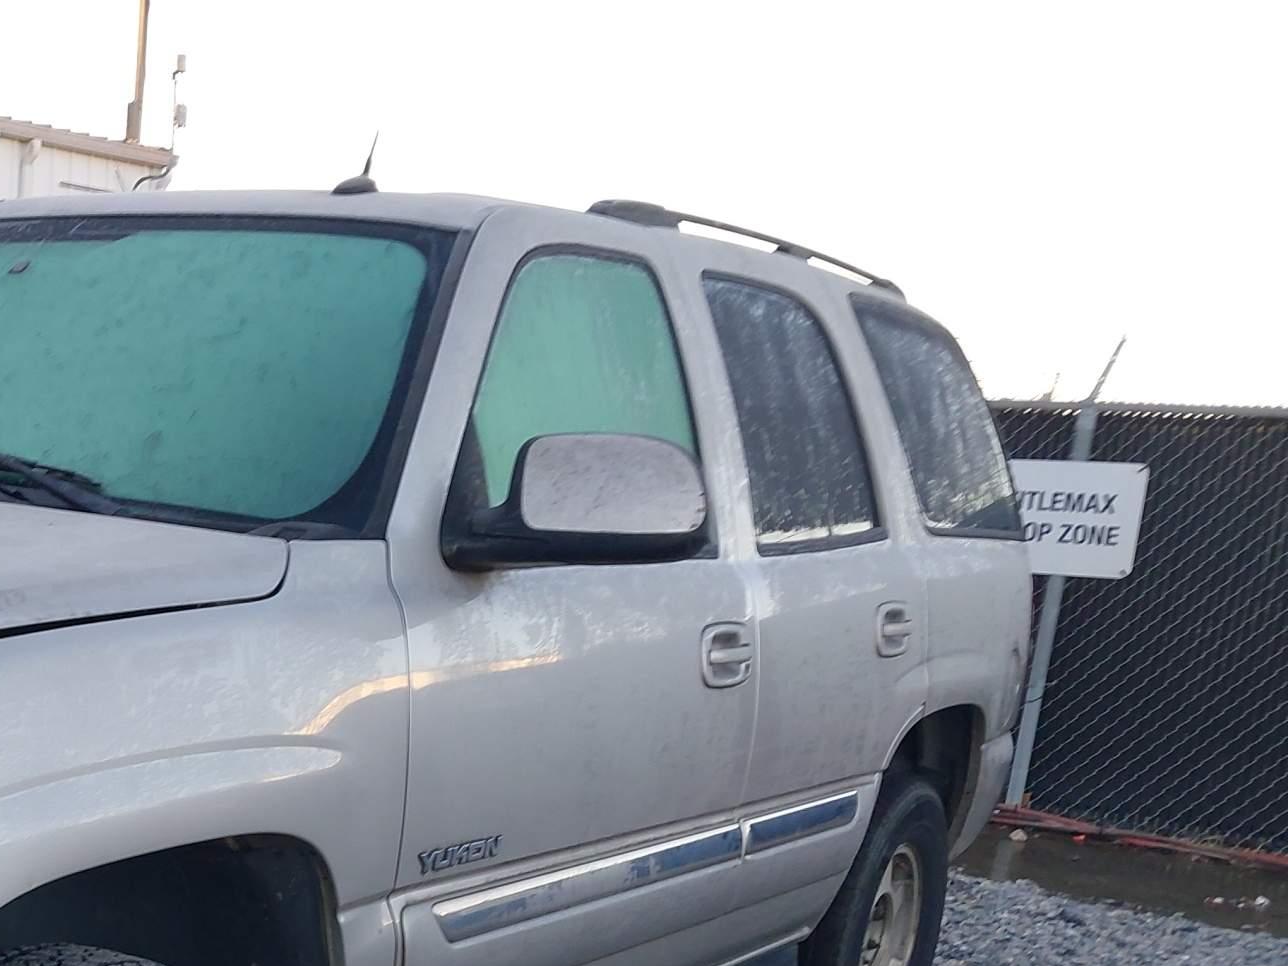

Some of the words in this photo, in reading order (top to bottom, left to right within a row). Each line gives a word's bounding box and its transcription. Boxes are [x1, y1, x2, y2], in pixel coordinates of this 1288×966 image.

[1024, 521, 1053, 542] OP
[1057, 523, 1120, 546] ZONE
[417, 834, 504, 875] YUKON
